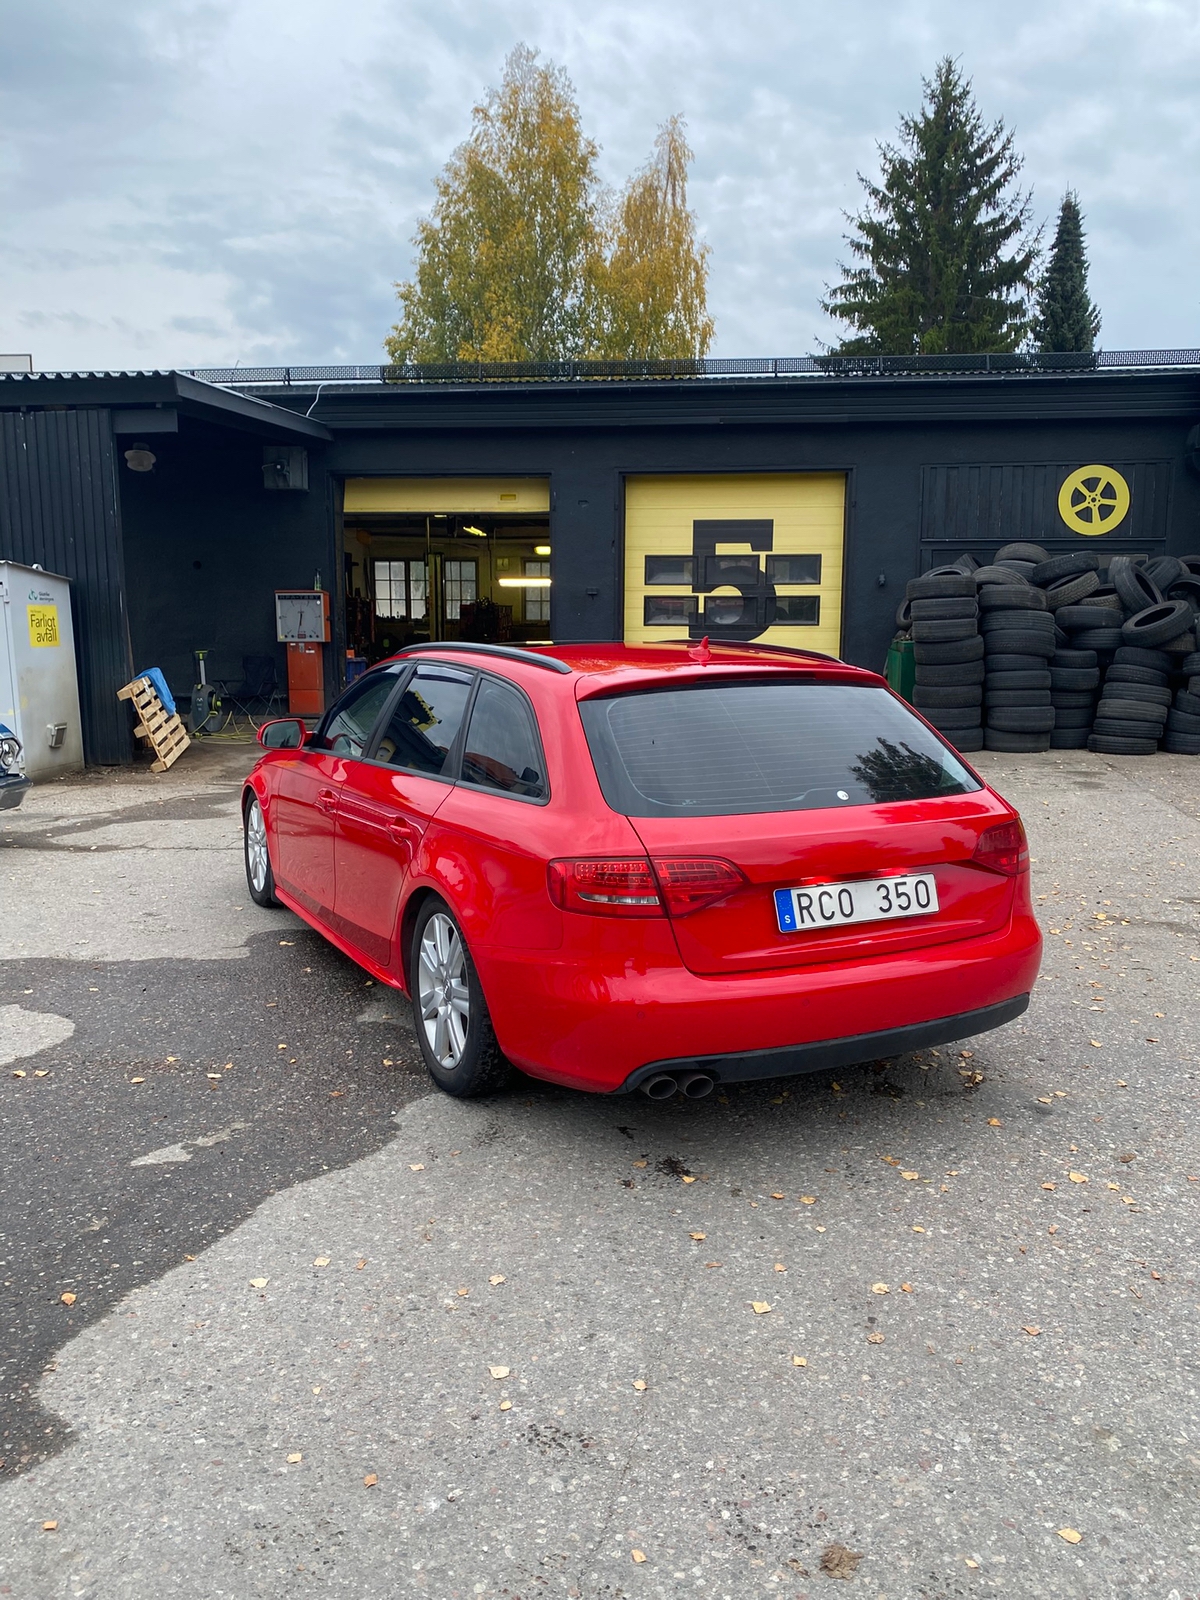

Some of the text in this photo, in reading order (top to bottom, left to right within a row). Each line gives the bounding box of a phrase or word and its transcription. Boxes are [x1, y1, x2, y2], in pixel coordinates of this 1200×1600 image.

[688, 519, 777, 642] 5
[30, 613, 56, 631] Farligt
[36, 627, 57, 642] avfall
[796, 879, 931, 924] RCO 350
[784, 914, 791, 924] S
